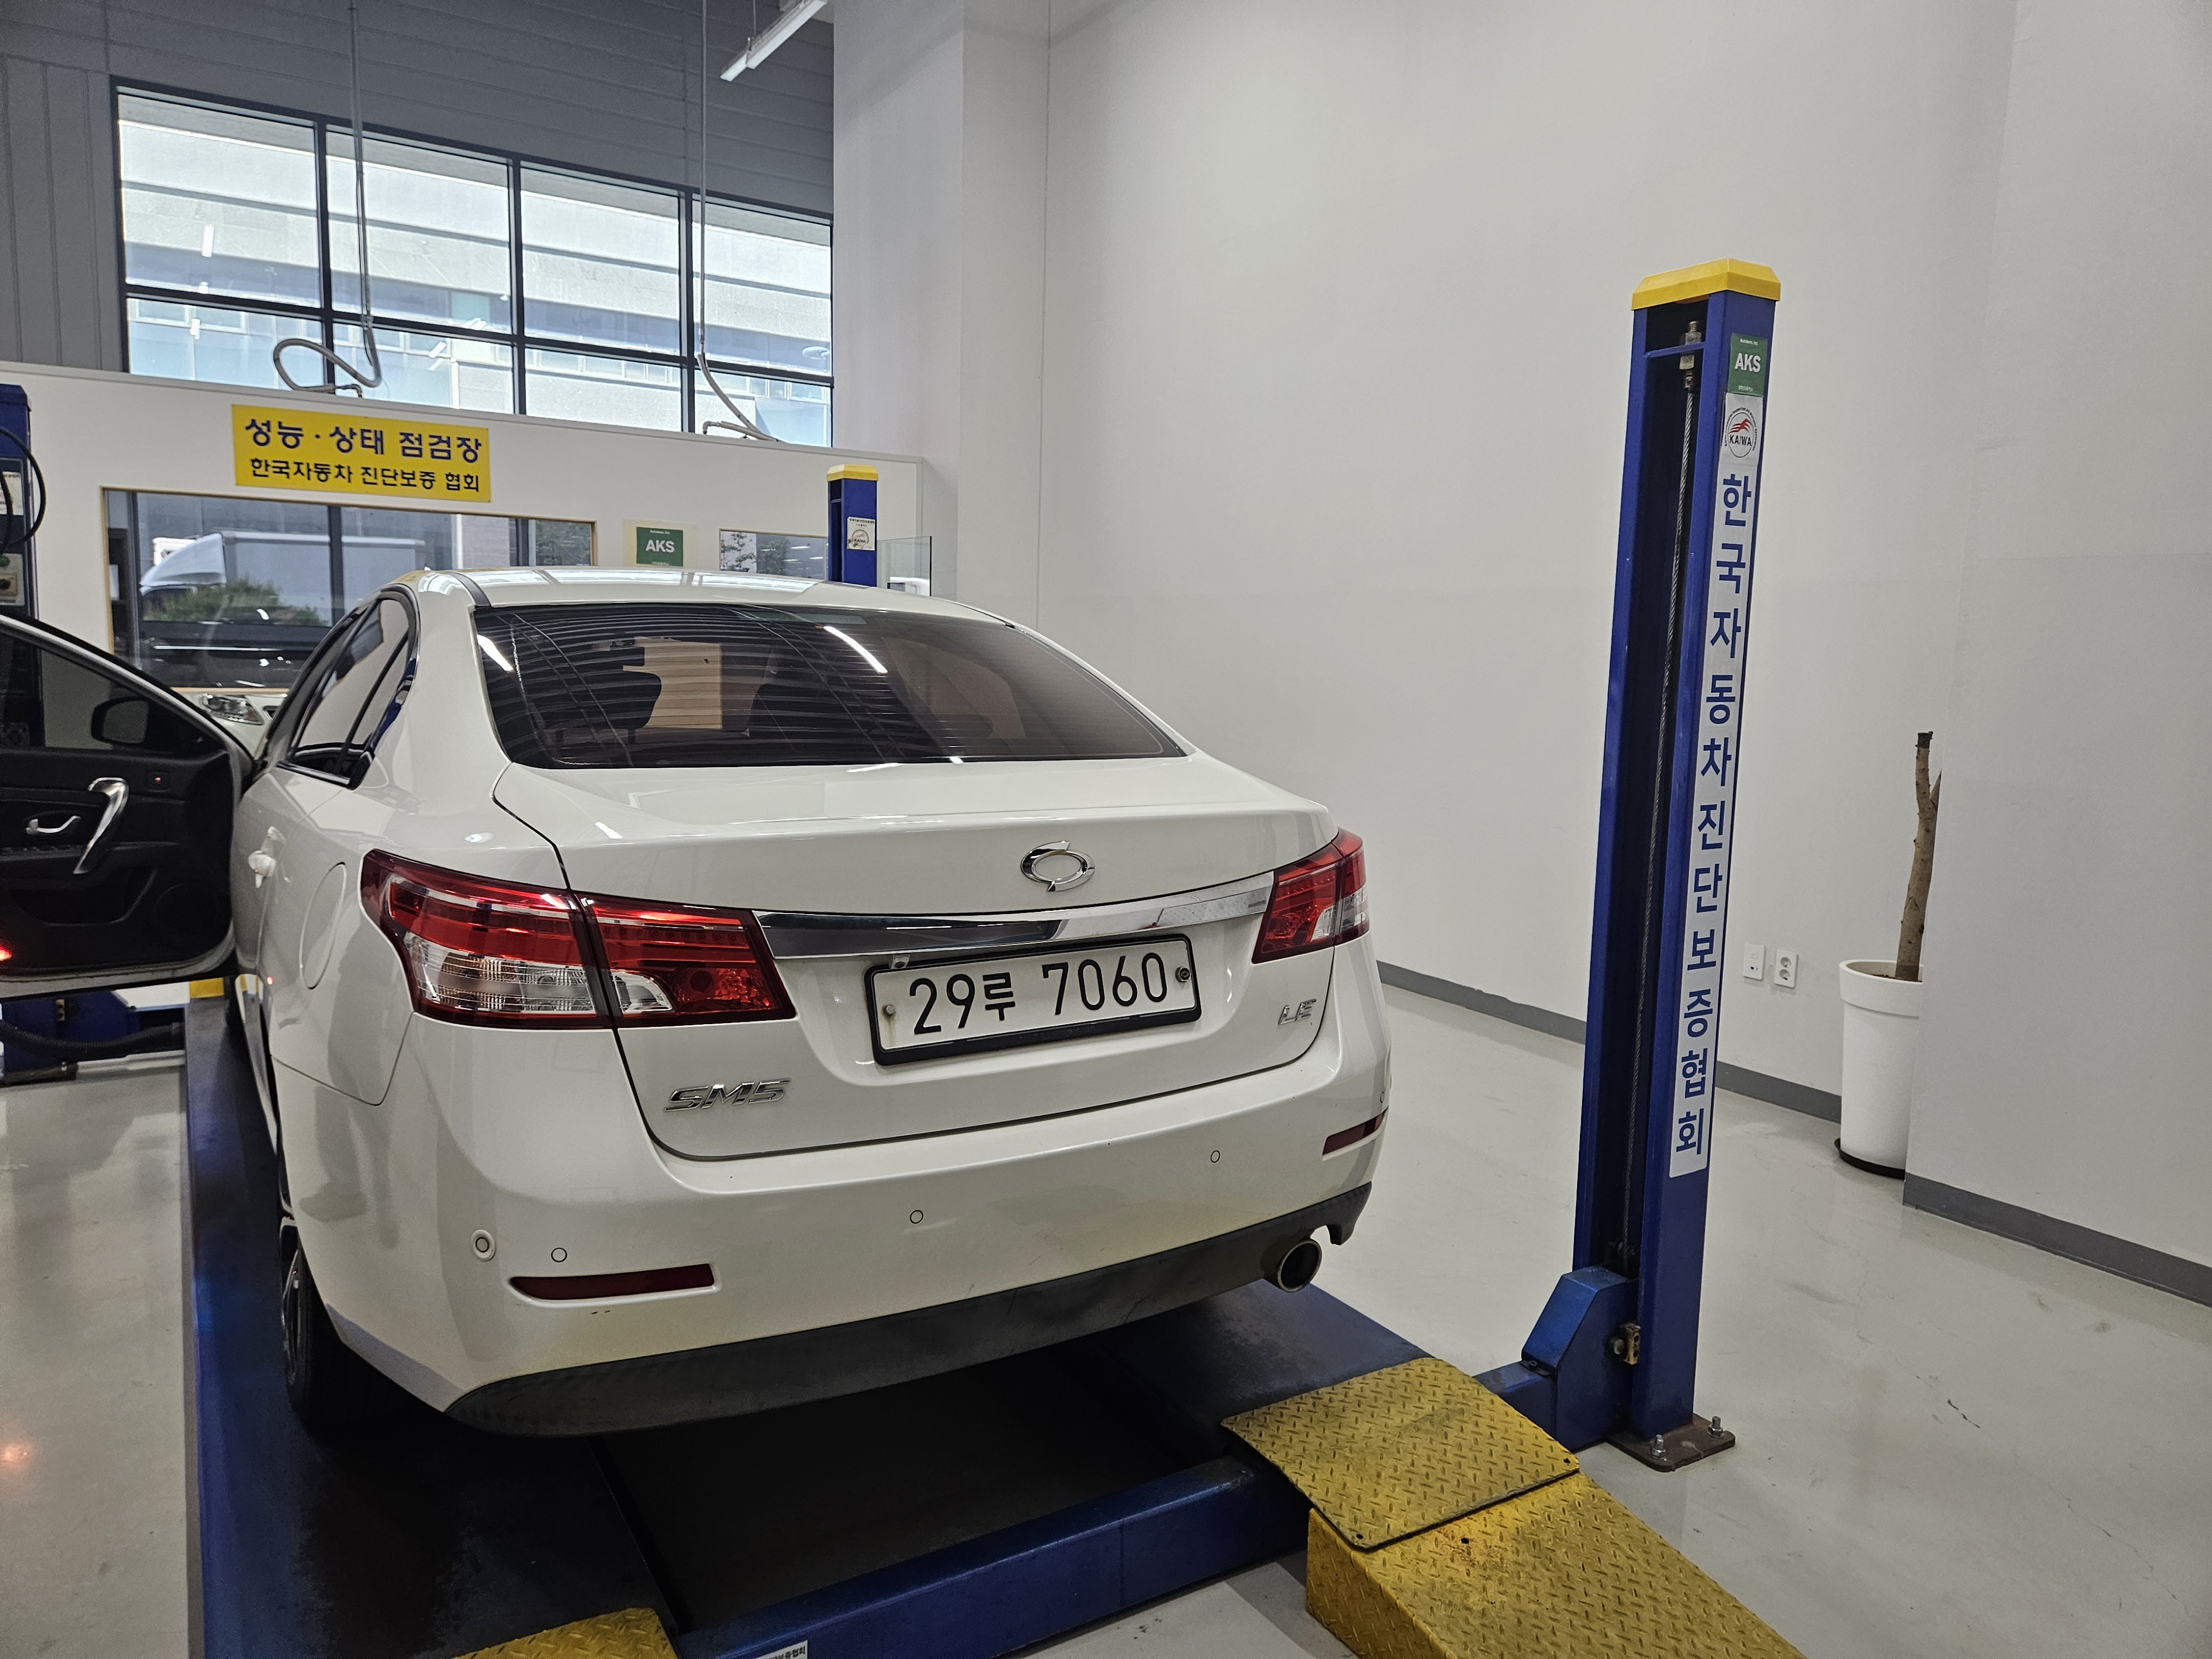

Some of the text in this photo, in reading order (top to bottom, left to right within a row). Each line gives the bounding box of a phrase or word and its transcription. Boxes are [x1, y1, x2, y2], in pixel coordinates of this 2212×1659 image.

[1734, 353, 1761, 373] AKS
[399, 431, 482, 463] 점검장
[1730, 434, 1752, 446] KAIWA
[251, 457, 479, 492] 한국자동차 진단보증 협회
[645, 539, 675, 553] AKS
[909, 952, 1167, 1035] 29루 7060
[1277, 999, 1317, 1026] LE
[663, 1078, 791, 1113] SM5
